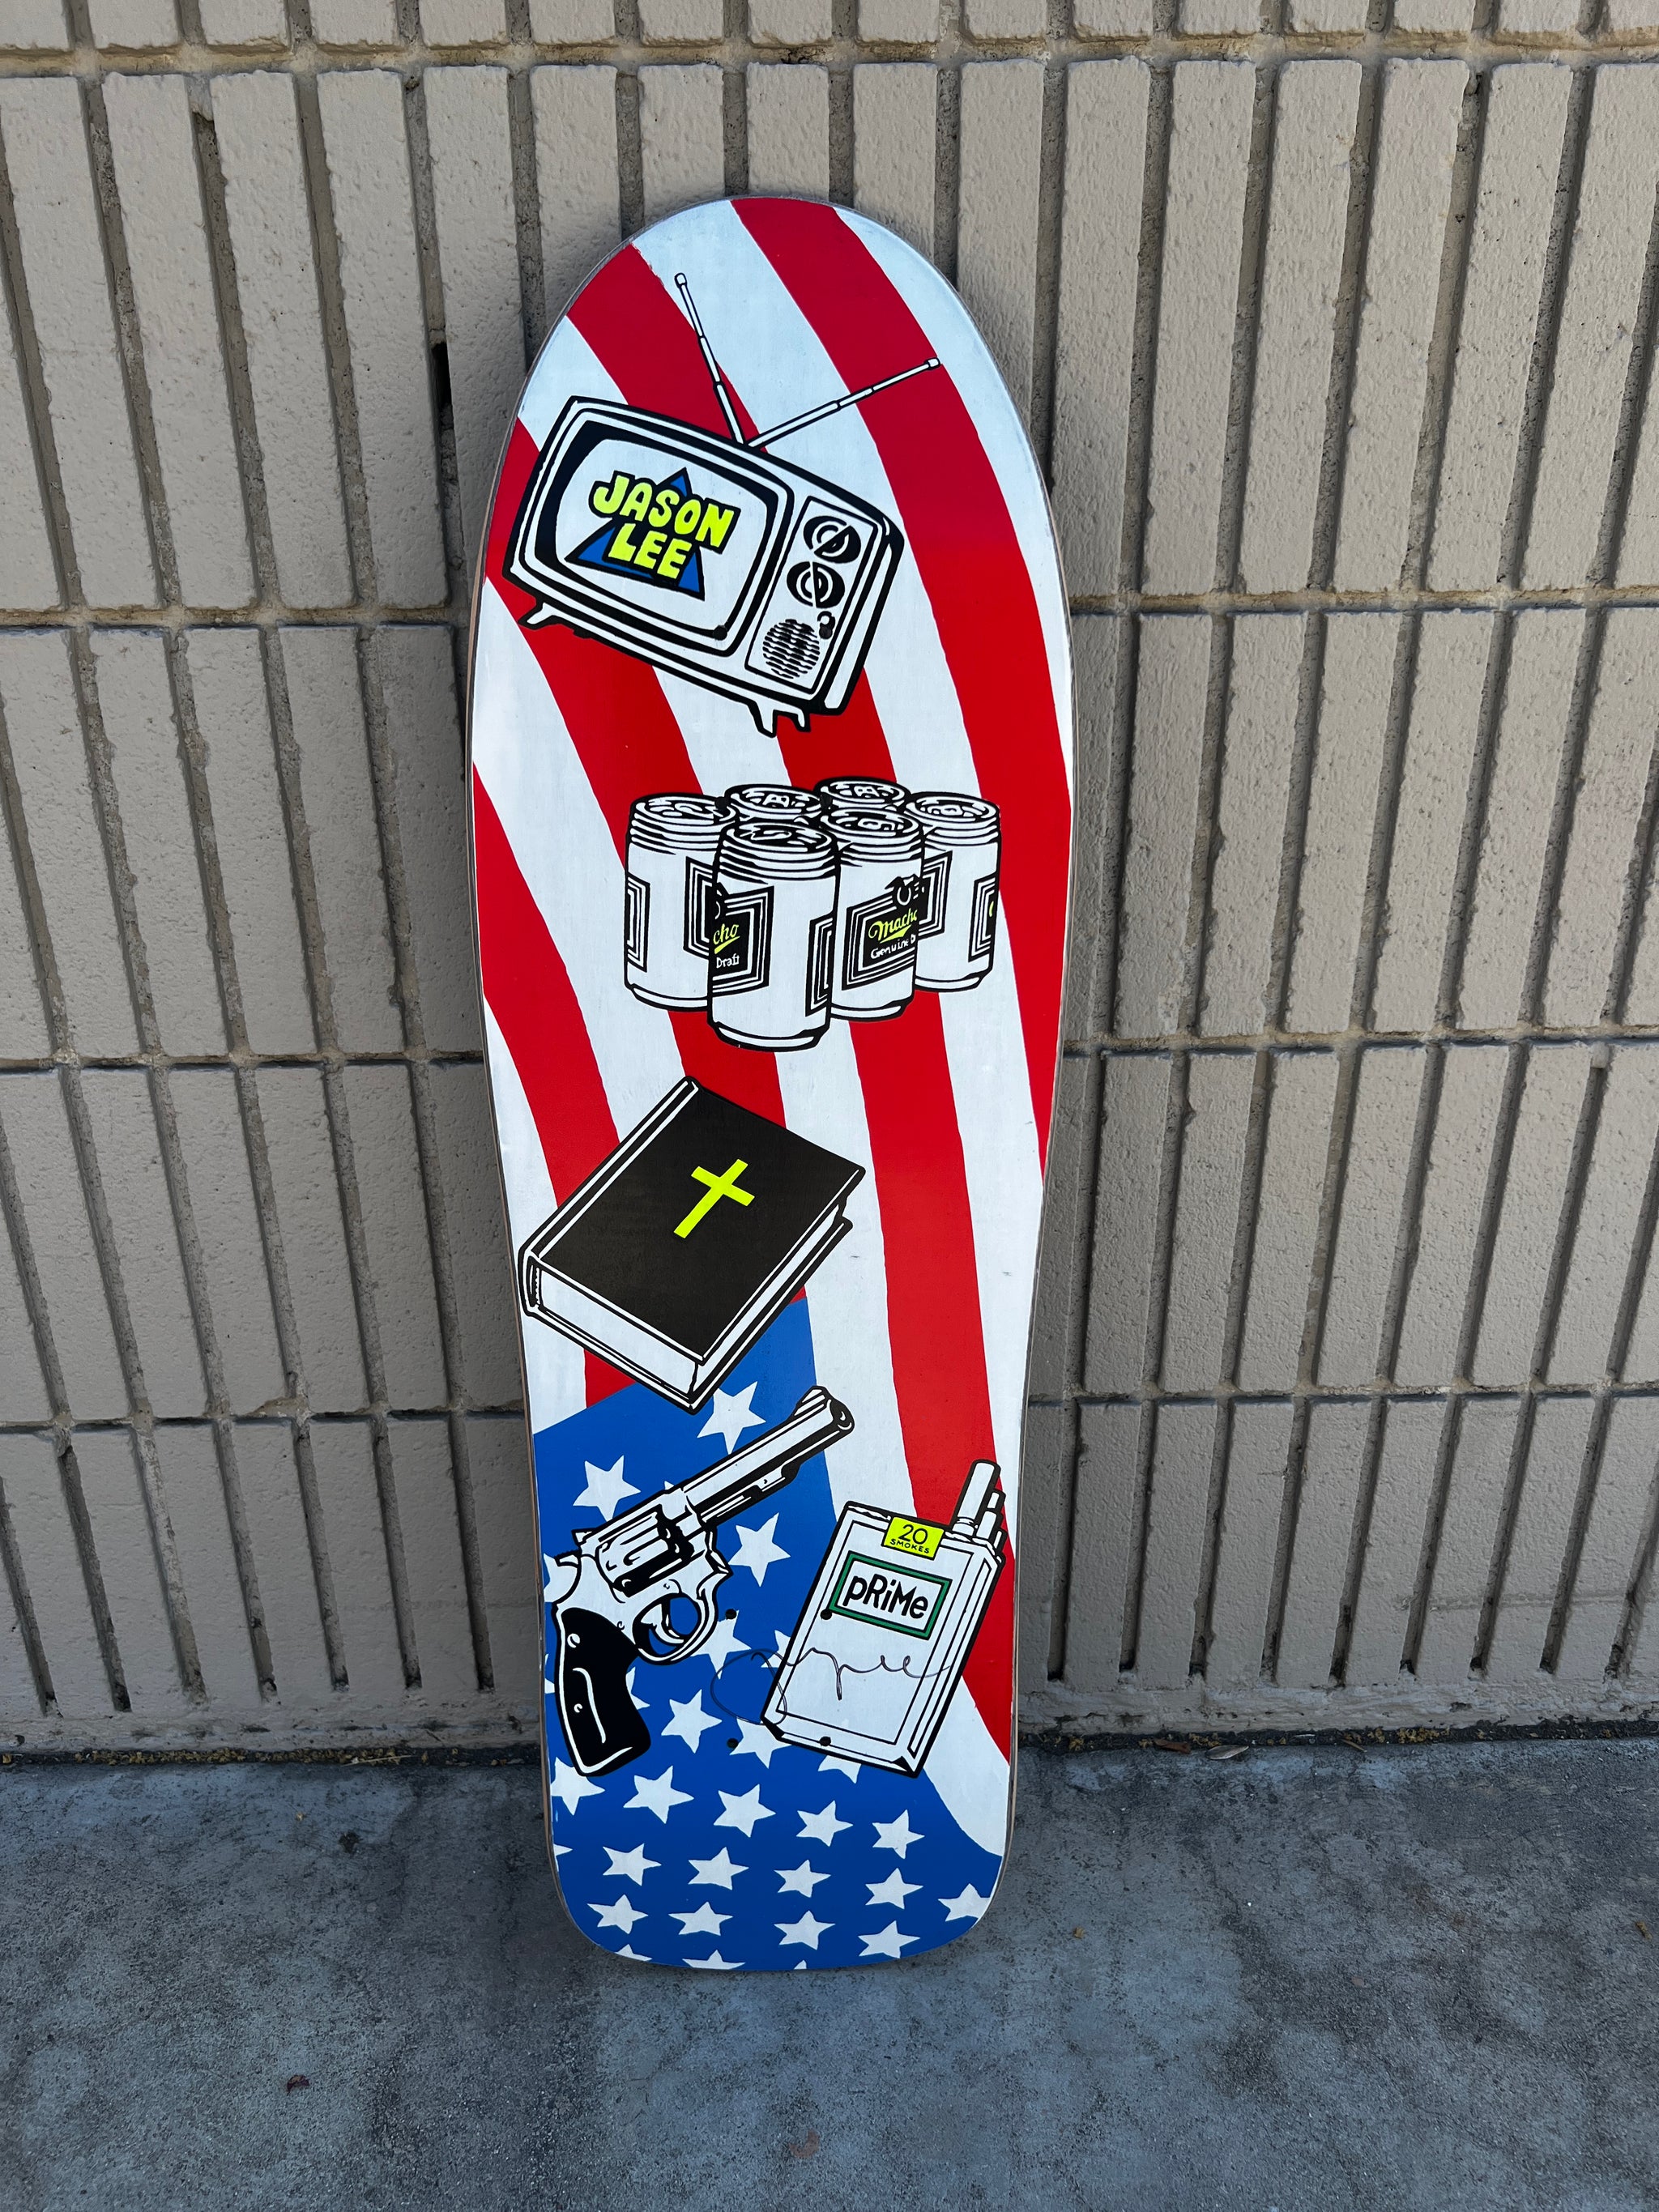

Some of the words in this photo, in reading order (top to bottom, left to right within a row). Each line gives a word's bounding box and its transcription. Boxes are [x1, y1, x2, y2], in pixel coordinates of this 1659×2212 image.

[592, 474, 736, 548] JASON
[607, 522, 693, 580] LEE
[716, 953, 740, 969] Draft
[889, 1538, 930, 1554] SMOKES
[898, 1524, 928, 1545] 20
[842, 1573, 929, 1619] pRiMe
